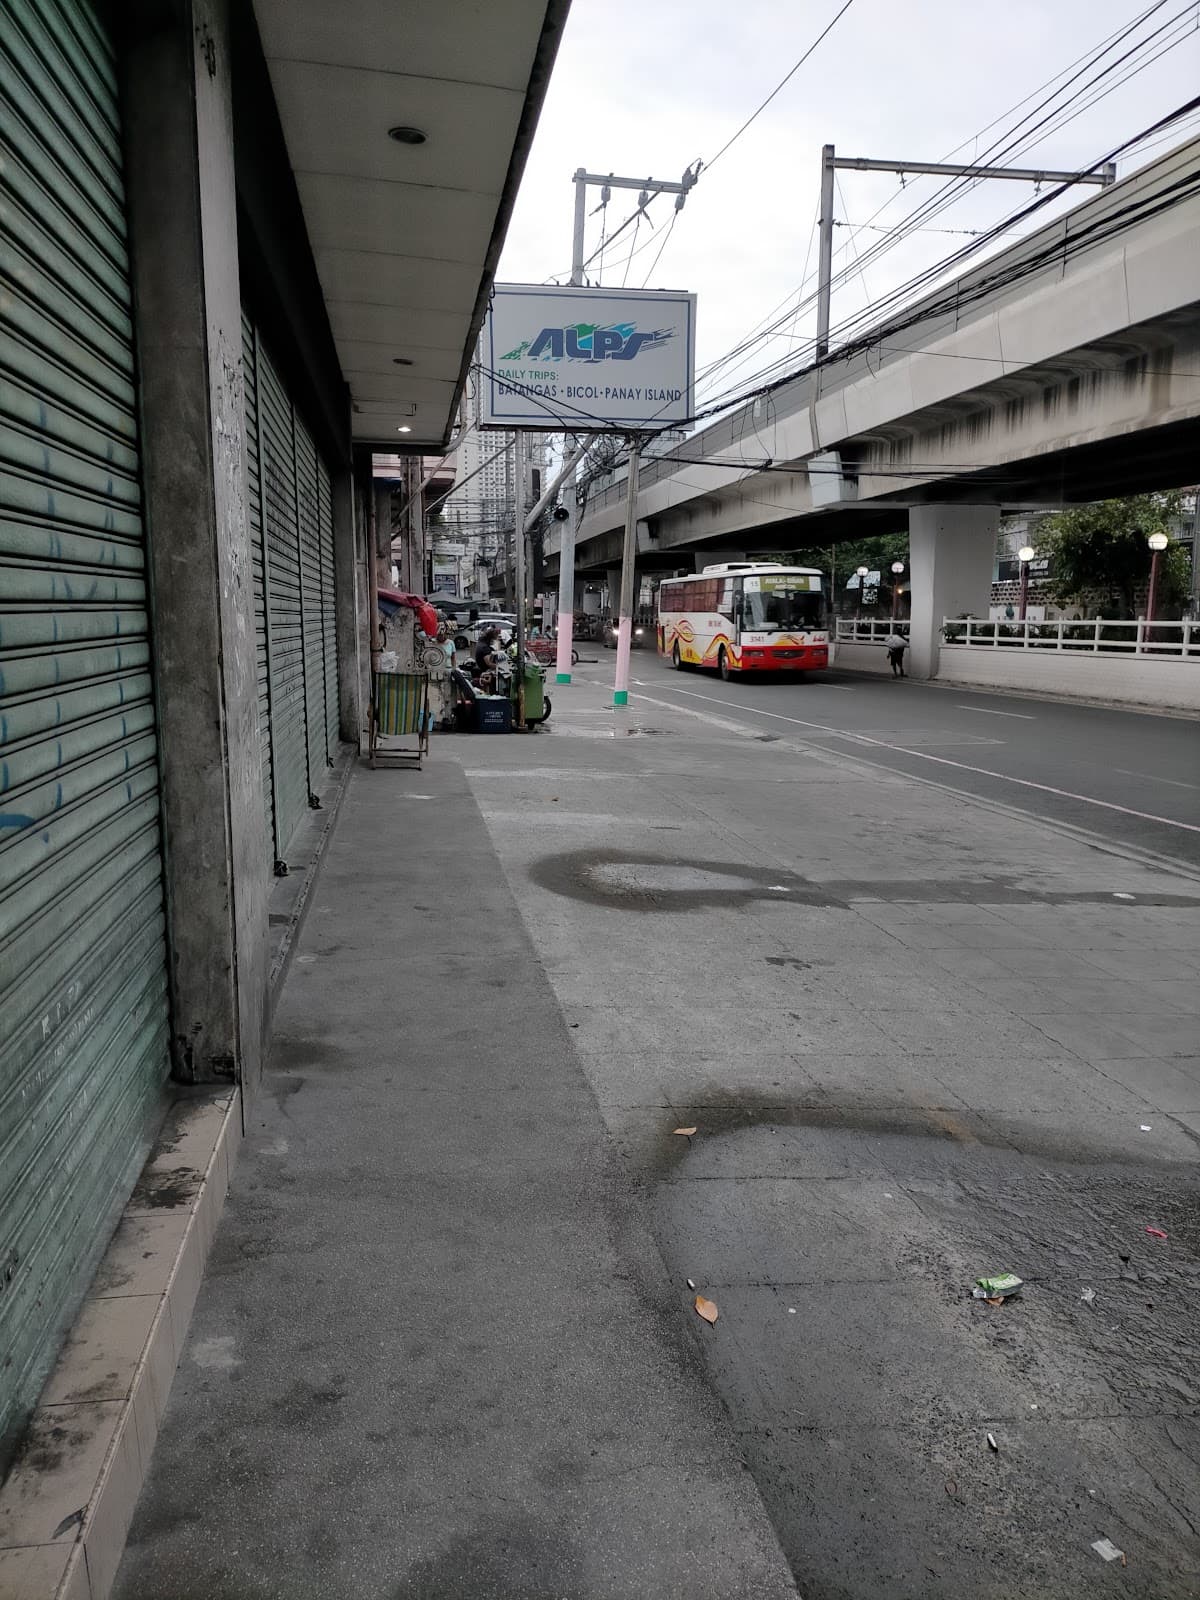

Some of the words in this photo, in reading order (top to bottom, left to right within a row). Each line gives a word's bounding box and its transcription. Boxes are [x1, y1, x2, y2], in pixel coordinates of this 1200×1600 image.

[527, 327, 655, 361] ALPS
[498, 369, 526, 379] DAILY
[529, 370, 560, 381] TRIPS:
[498, 383, 557, 397] BATANGAS
[567, 386, 599, 398] BICOL
[605, 387, 642, 400] PANAY
[645, 388, 681, 401] ISLAND
